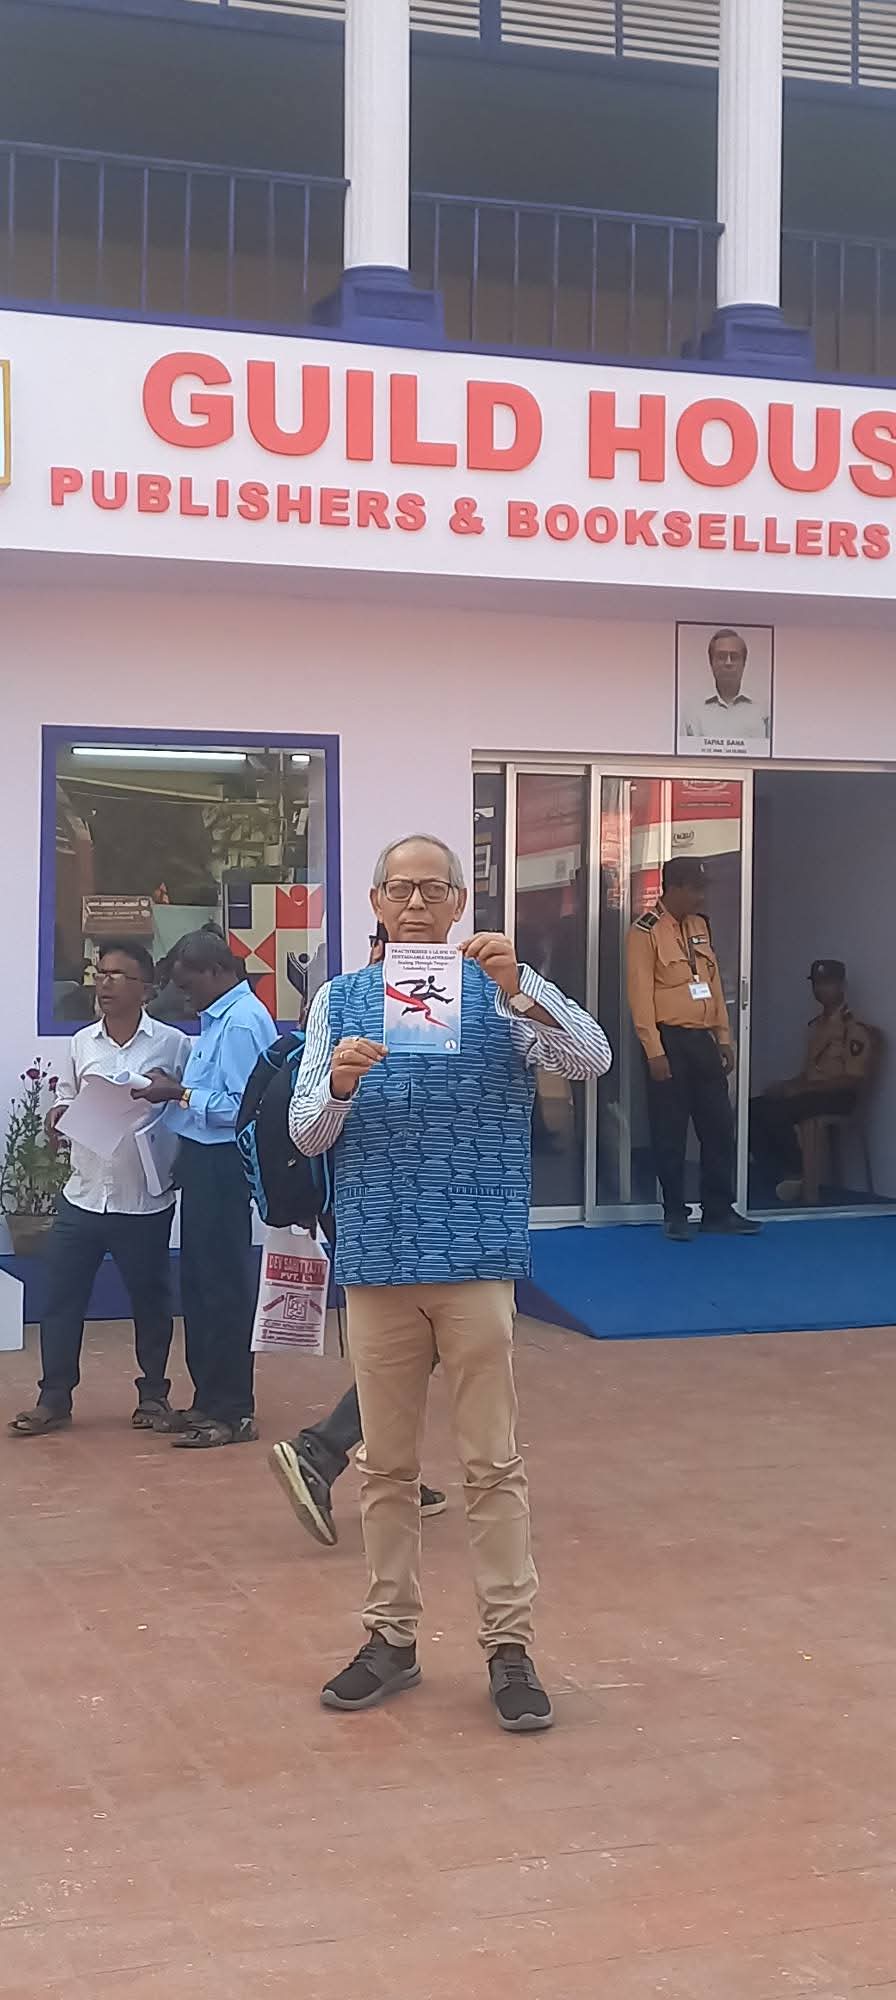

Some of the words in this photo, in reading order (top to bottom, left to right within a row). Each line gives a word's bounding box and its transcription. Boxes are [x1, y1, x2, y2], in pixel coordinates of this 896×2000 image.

[142, 352, 543, 473] GUILD
[51, 467, 427, 533] PUBLISHERS
[449, 497, 484, 536] &
[507, 501, 891, 561] BOOKSELLERS
